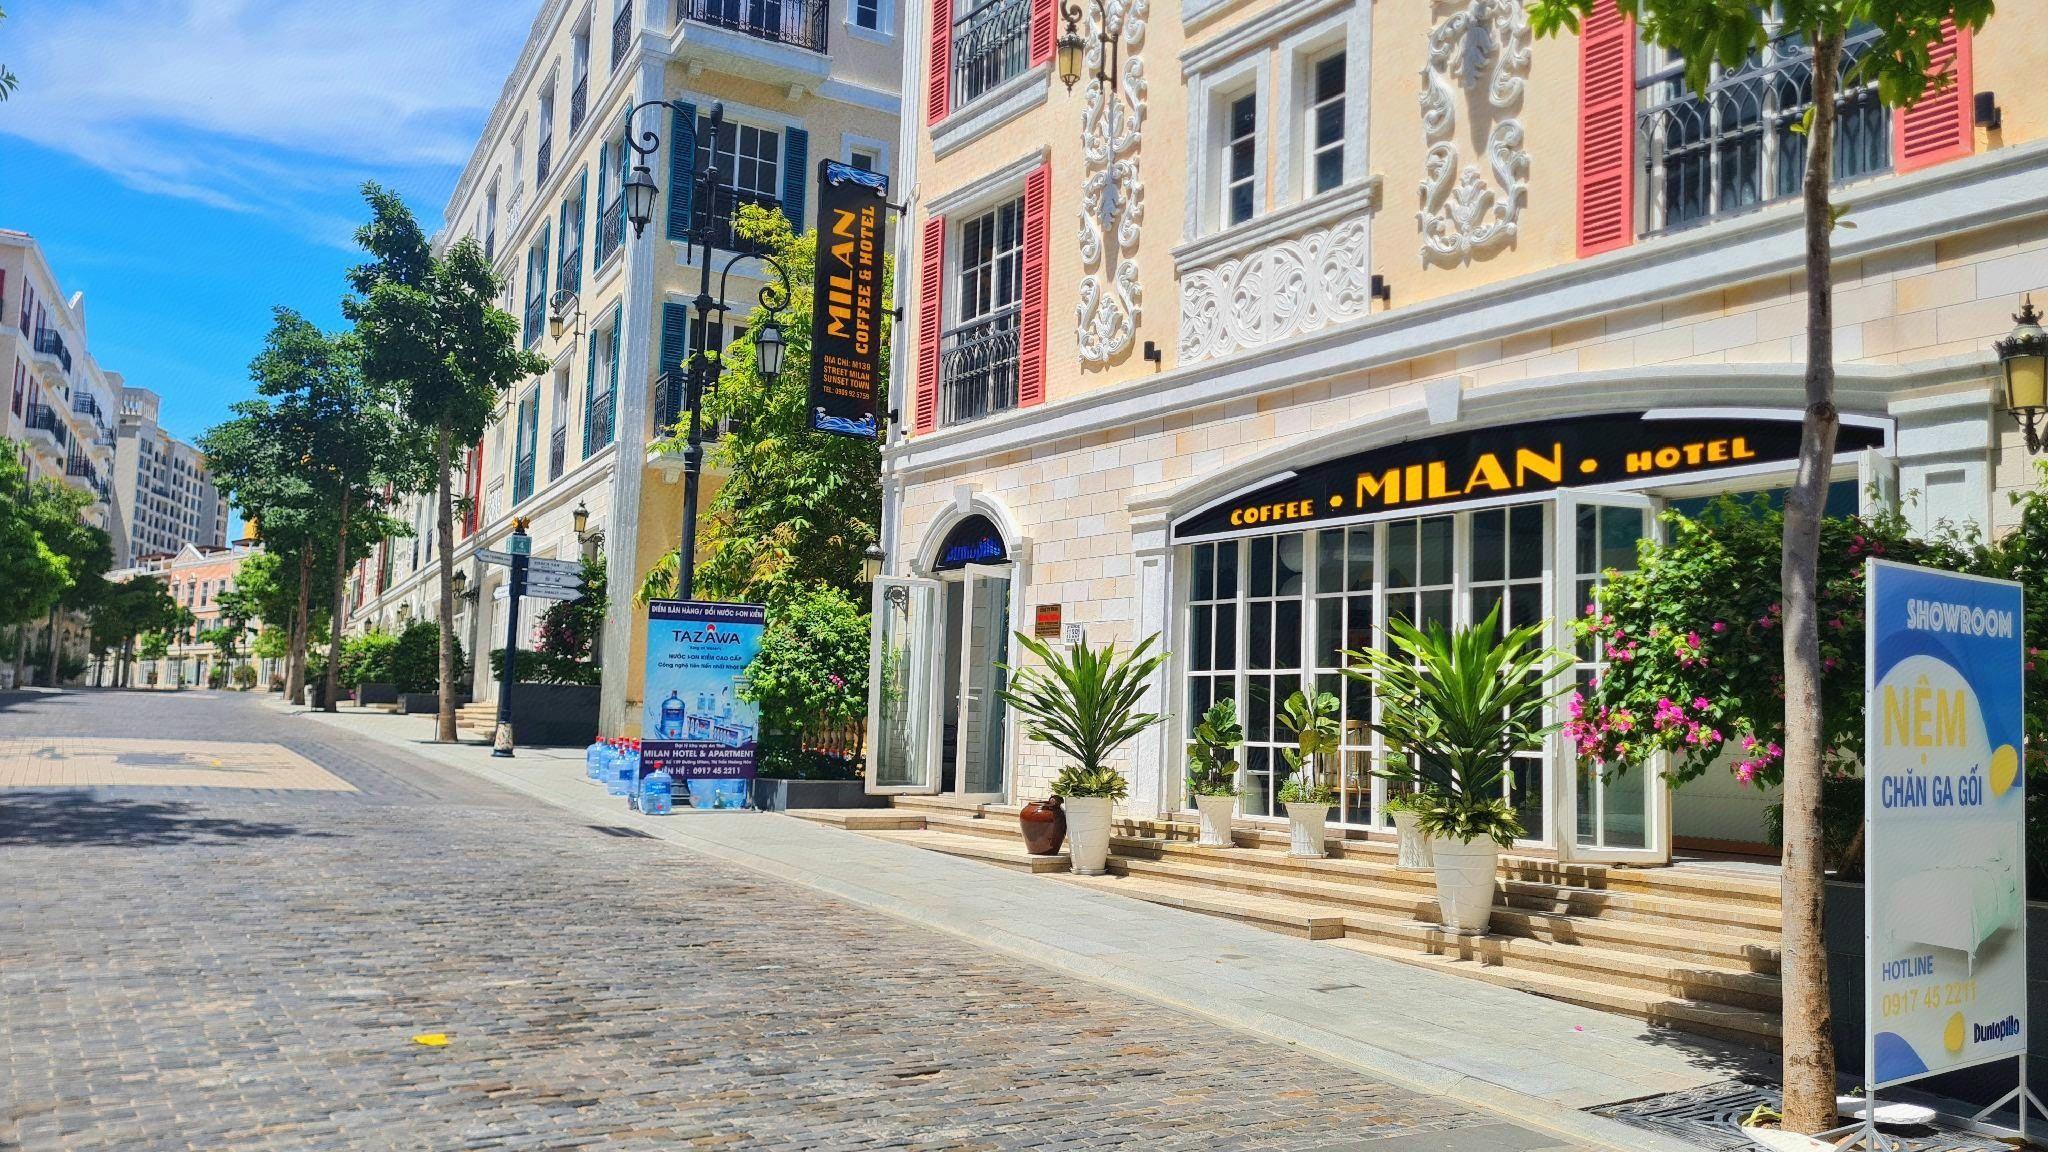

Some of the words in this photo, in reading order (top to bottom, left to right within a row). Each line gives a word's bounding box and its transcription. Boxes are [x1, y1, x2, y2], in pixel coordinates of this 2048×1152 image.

[860, 206, 874, 266] HOTEL
[828, 208, 856, 338] MILAN
[859, 269, 872, 280] &
[856, 284, 871, 354] COFFEE
[824, 366, 848, 376] STREET
[849, 371, 870, 380] MILAN
[824, 374, 849, 386] SUNSET
[850, 379, 870, 390] TOWN
[1230, 499, 1314, 526] COFFEE
[1356, 442, 1562, 508] MILAN
[1625, 437, 1756, 473] HOTEL
[1907, 598, 2012, 639] SHOWROOM
[672, 630, 740, 644] TAZAWA
[1883, 673, 1967, 765] NỆM
[708, 750, 754, 758] APARTMENT
[1881, 768, 1927, 808] CHĂN
[1932, 775, 1953, 807] GA
[1958, 763, 1983, 806] GỐI
[1882, 955, 1934, 982] HOTLINE
[1882, 988, 1920, 1018] 0917
[1924, 985, 1941, 1008] 45
[1973, 1014, 2020, 1044] Dunlopillo
